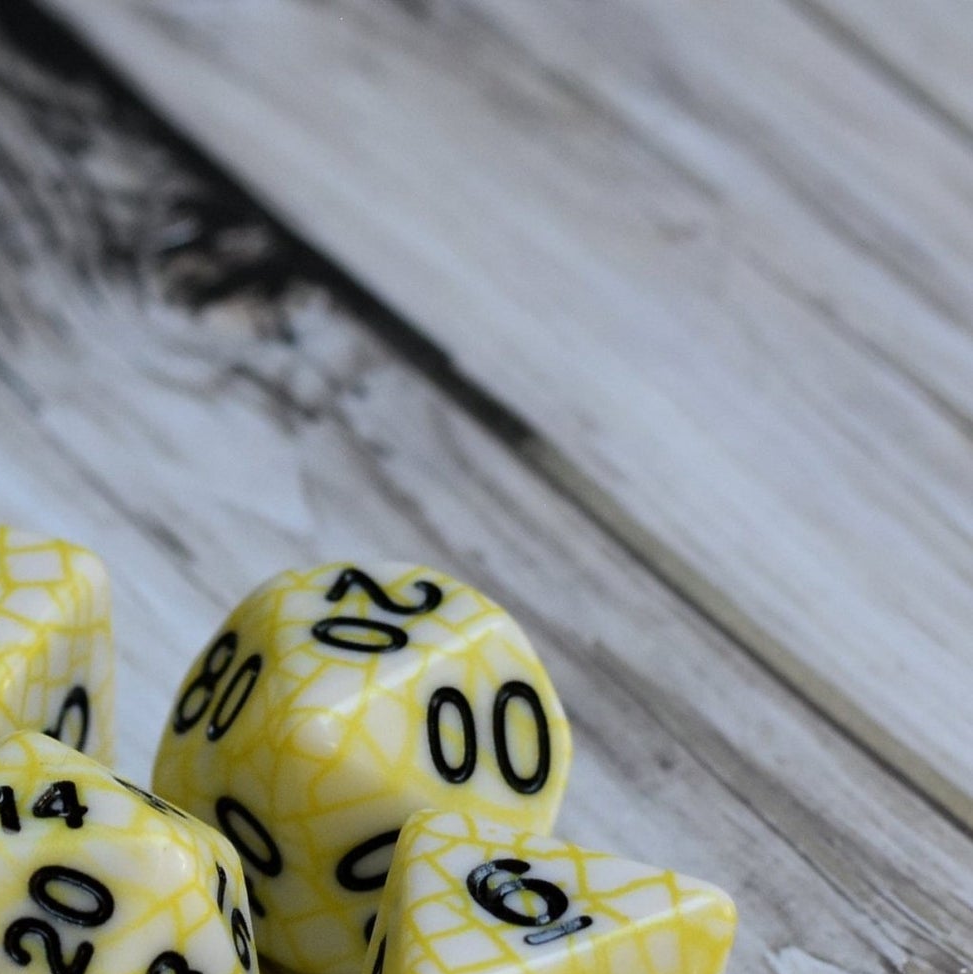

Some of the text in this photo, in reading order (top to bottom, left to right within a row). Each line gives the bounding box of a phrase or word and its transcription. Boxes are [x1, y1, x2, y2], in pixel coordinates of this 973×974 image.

[311, 568, 442, 653] 20
[173, 630, 262, 742] 80
[428, 680, 551, 795] 00
